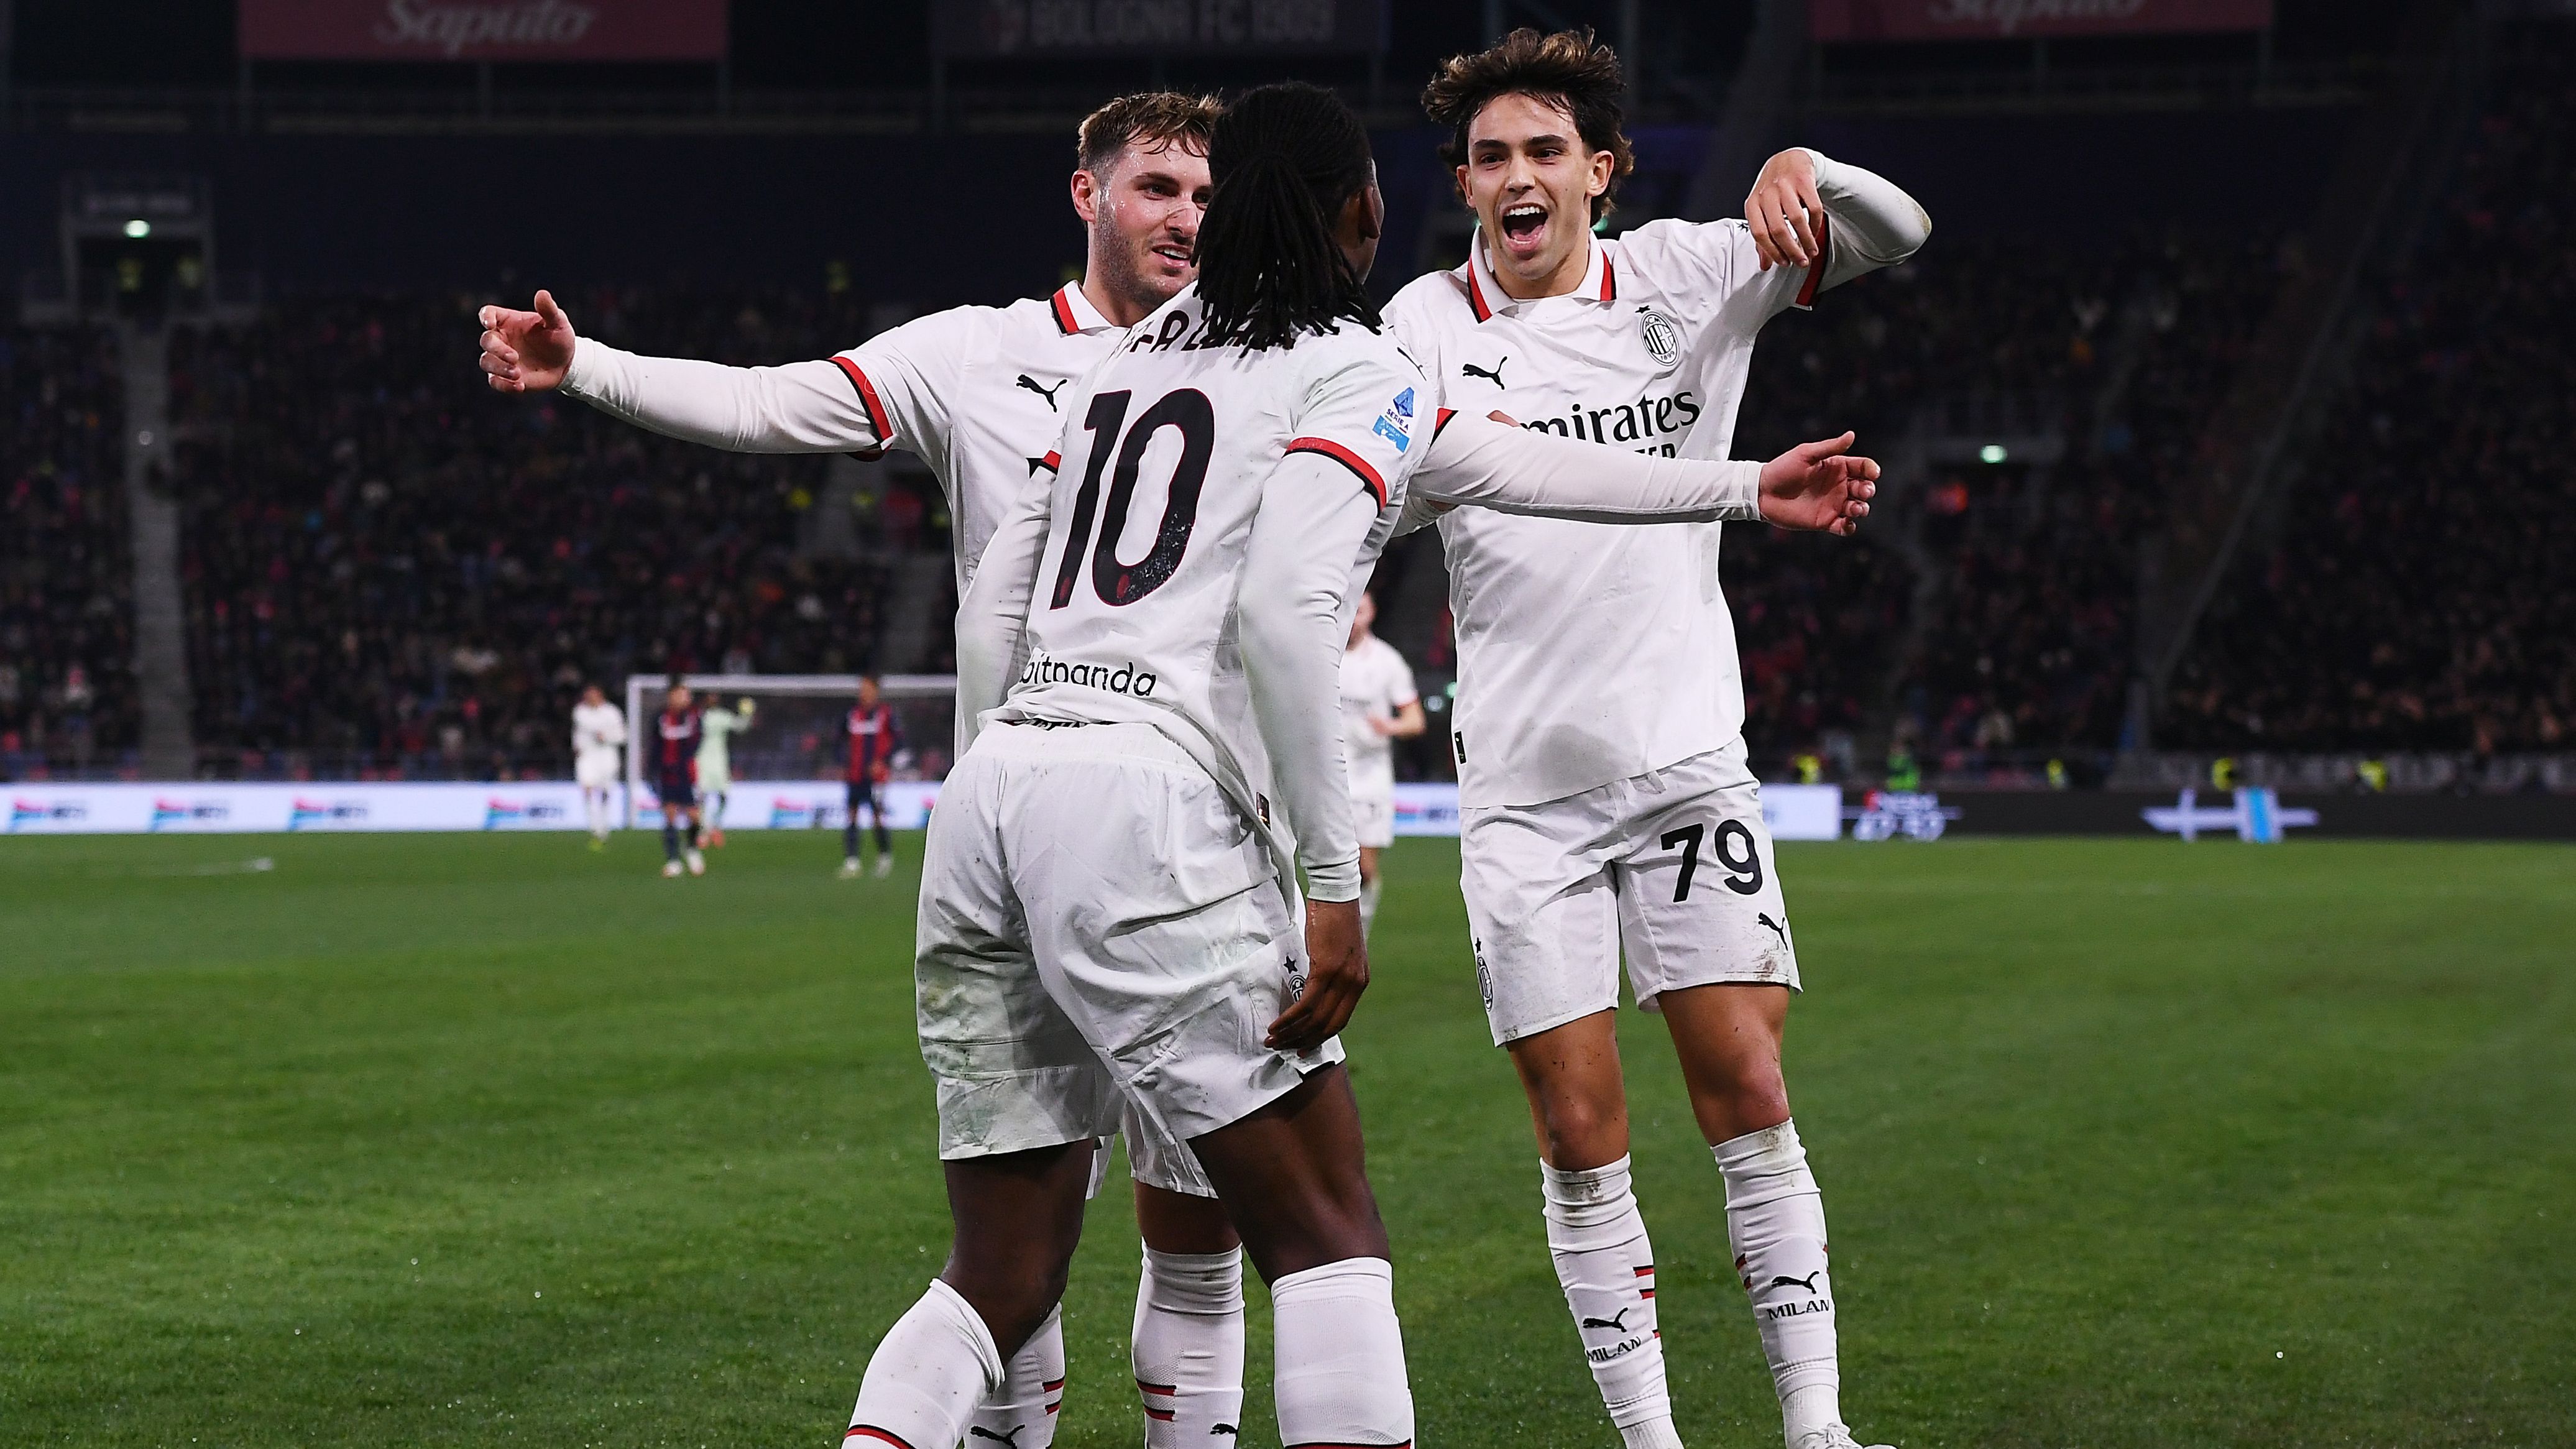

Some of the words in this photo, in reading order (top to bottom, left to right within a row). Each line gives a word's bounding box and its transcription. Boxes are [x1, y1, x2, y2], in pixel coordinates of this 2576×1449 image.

[1660, 351, 1675, 361] 1899
[1386, 408, 1404, 426] SERIE
[1519, 391, 1701, 445] mirates
[1049, 387, 1215, 610] 10
[1660, 819, 1763, 903] 79
[1766, 1299, 1830, 1320] MILAN
[1586, 1336, 1641, 1361] MILAN
